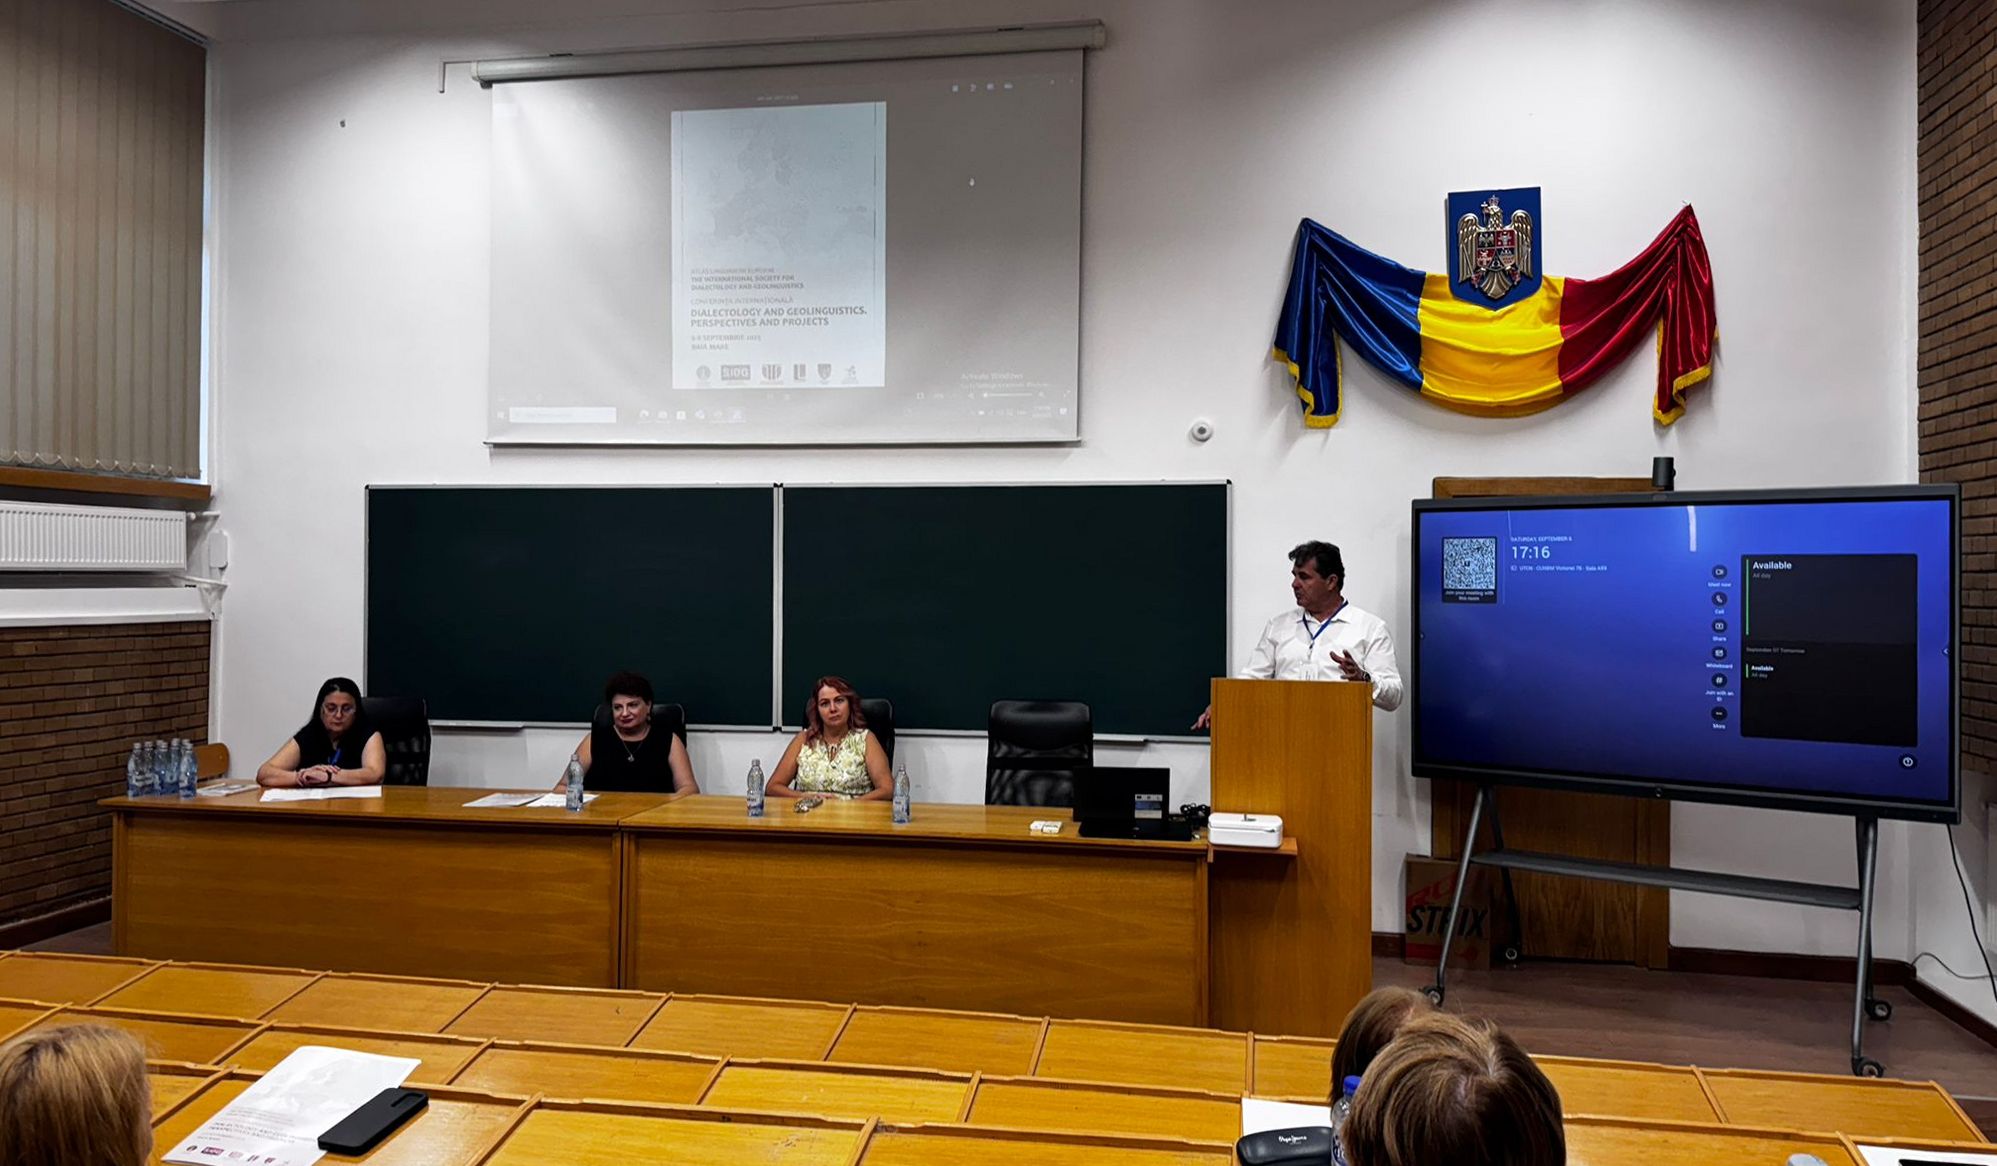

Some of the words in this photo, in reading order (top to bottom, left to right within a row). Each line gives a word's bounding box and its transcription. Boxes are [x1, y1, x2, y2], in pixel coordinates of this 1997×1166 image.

[691, 308, 761, 317] DIALECTOLOGY
[763, 307, 785, 316] AND
[787, 306, 867, 316] GEOLINGUISTICS.
[691, 318, 756, 327] PERSPECTIVES
[760, 318, 780, 326] AND
[783, 317, 830, 326] PROJECTS
[1512, 546, 1550, 559] 17:16
[1753, 561, 1792, 570] Available
